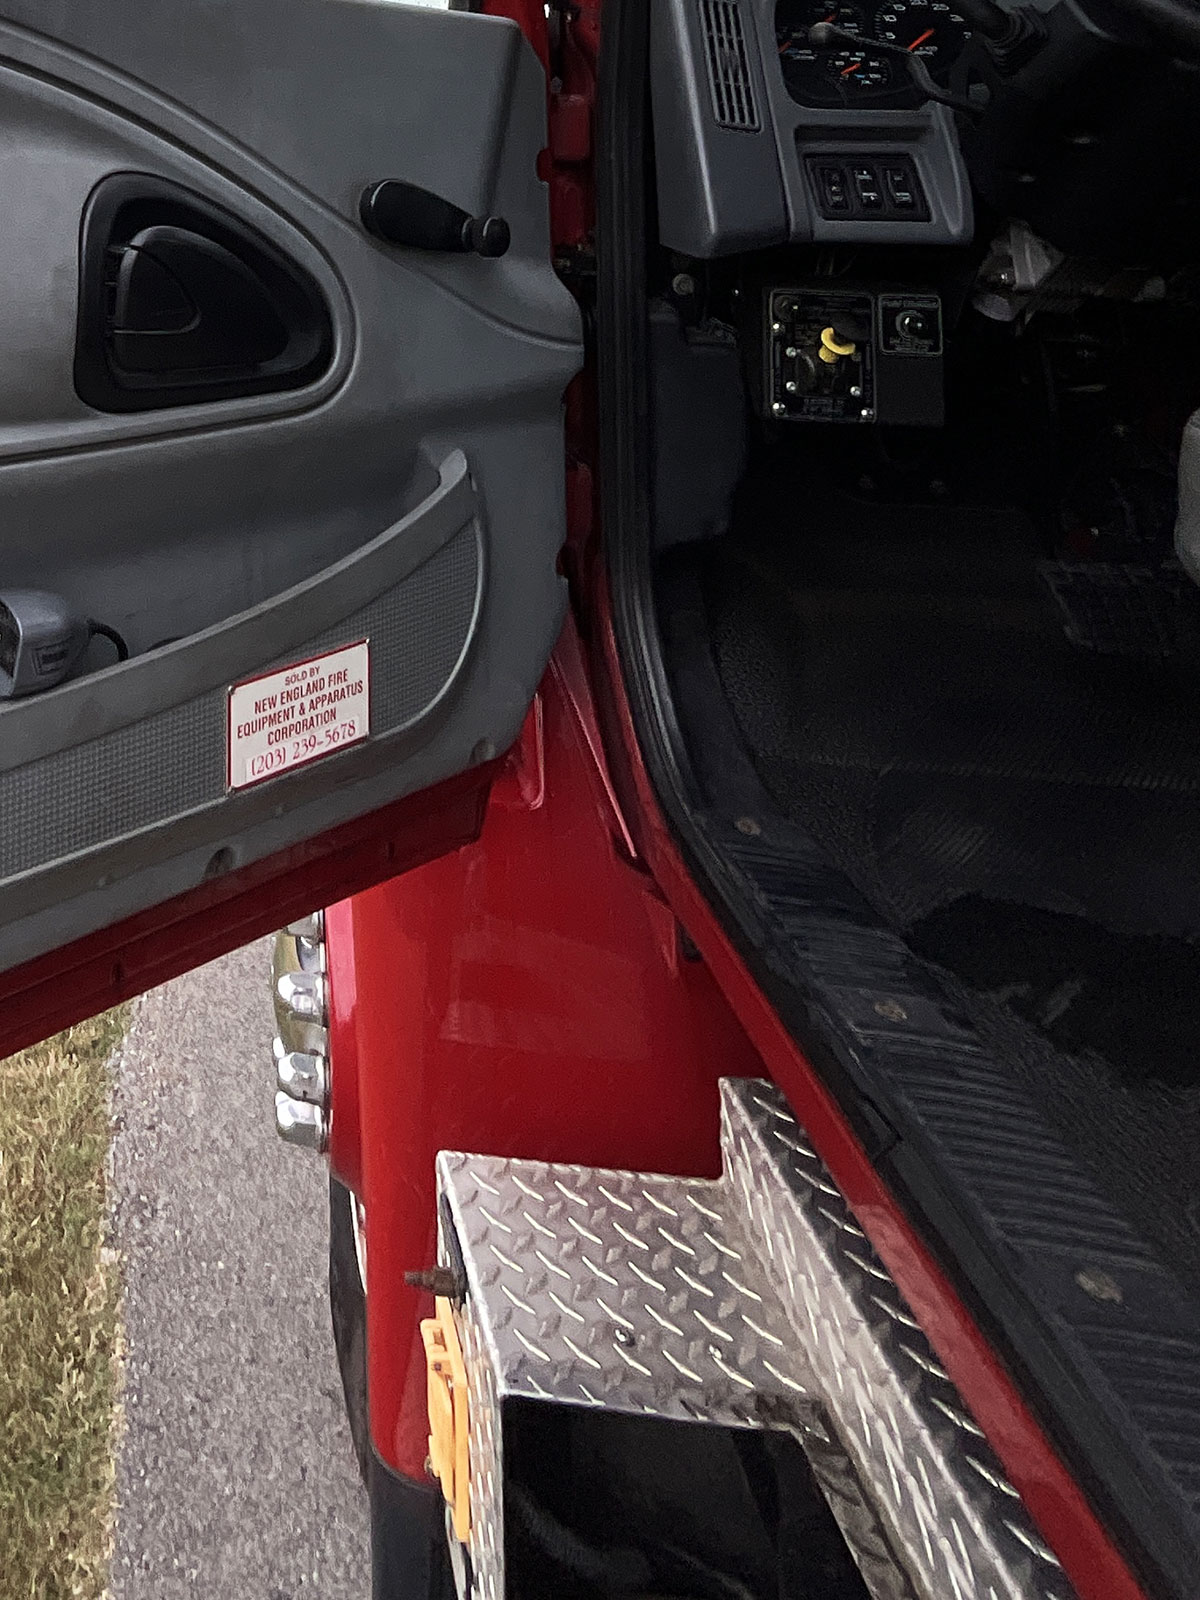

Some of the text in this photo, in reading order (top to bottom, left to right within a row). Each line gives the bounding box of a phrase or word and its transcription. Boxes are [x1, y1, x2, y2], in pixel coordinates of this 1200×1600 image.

[254, 668, 349, 714] NEW ENGLAND FIRE
[285, 666, 320, 686] SOLD BY
[237, 680, 364, 739] EQUIPMENT & APPARATUS
[267, 707, 337, 746] CORPORATION
[251, 719, 356, 776] (203) 239-5678
